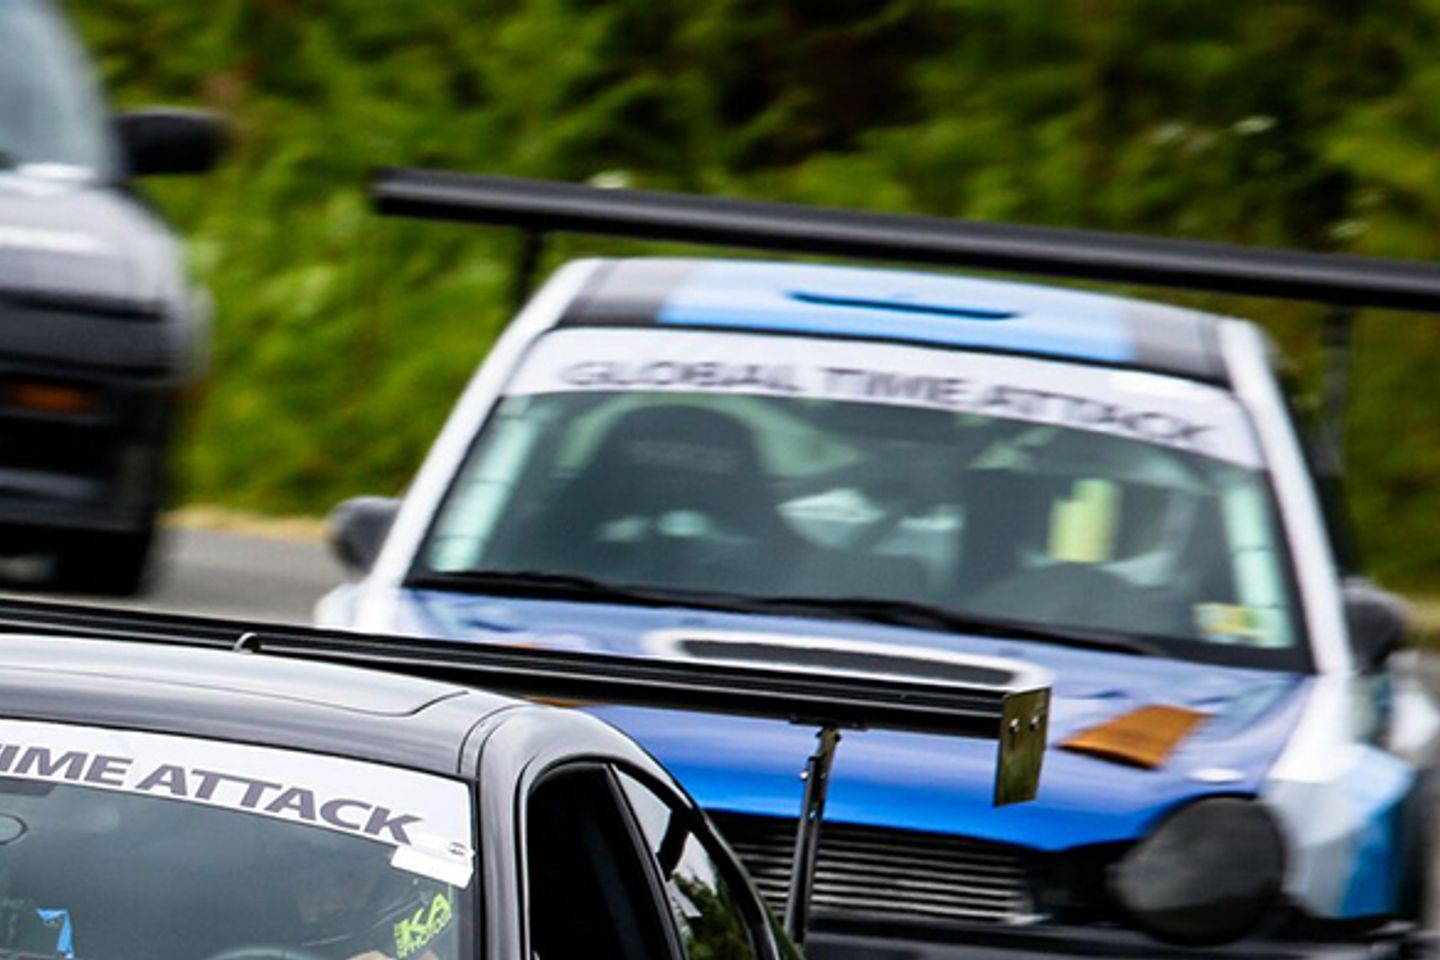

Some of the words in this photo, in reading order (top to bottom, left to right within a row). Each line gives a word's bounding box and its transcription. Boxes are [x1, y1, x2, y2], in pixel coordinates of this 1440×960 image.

[566, 361, 806, 394] GLOBAL
[816, 366, 962, 407] TIME
[968, 384, 1220, 444] ATTACK
[136, 766, 424, 846] ATTACK
